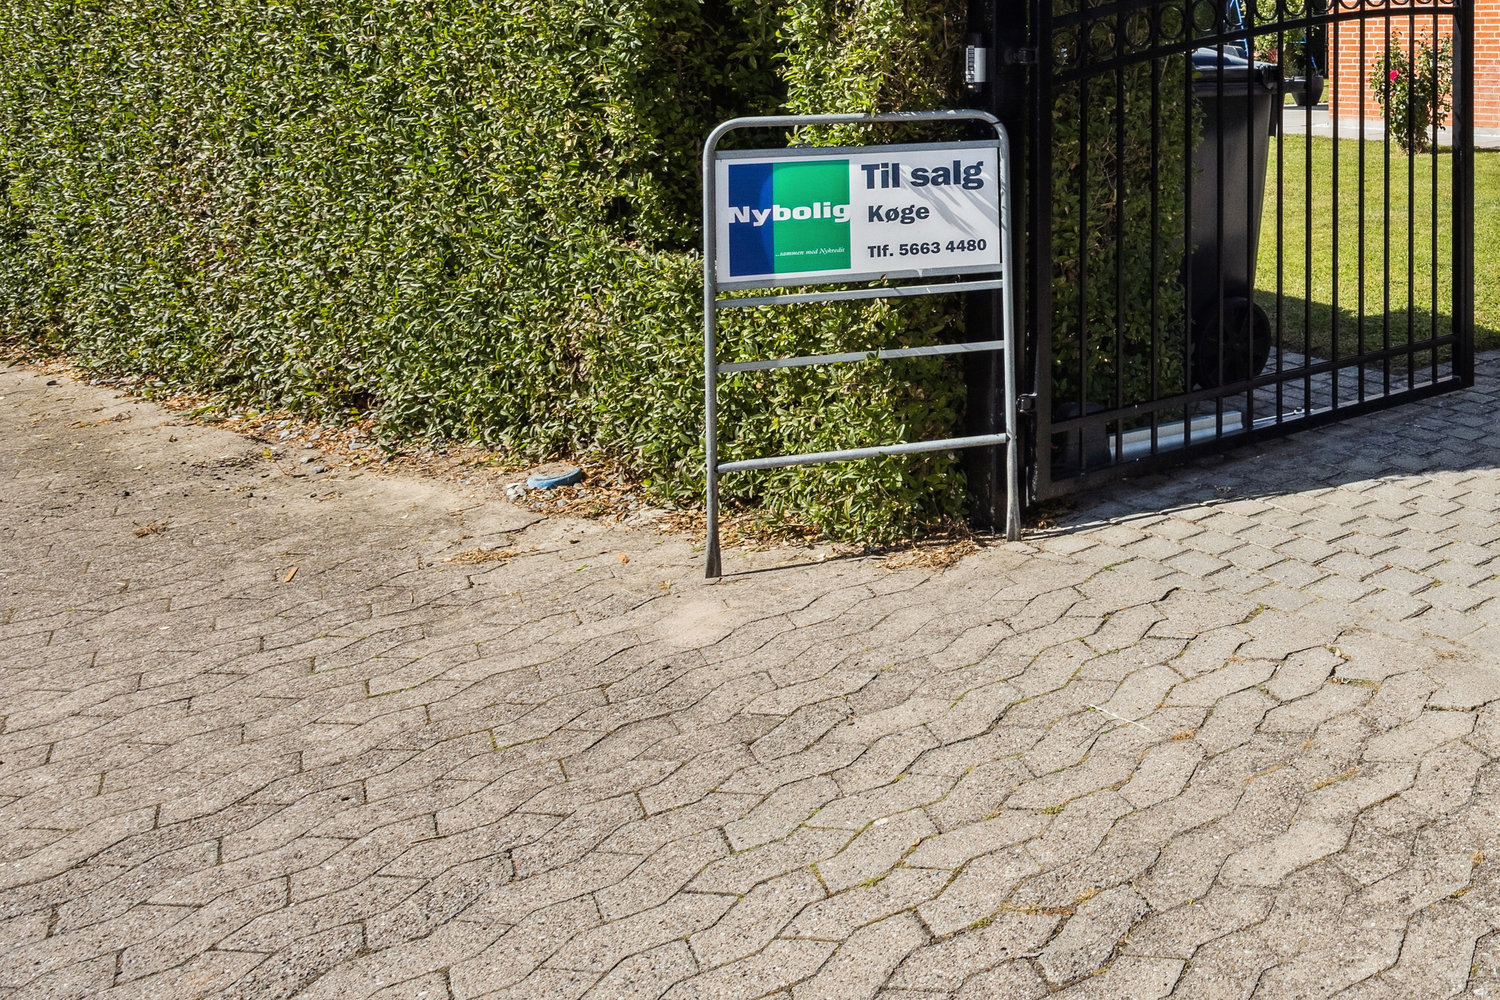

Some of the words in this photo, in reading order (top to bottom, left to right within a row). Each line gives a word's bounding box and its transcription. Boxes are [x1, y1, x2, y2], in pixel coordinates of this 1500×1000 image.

[861, 162, 900, 190] Til
[910, 159, 984, 190] salg
[728, 201, 851, 227] Nybolig
[868, 204, 930, 225] Køge
[867, 244, 894, 258] Tlf.
[899, 241, 941, 257] 5663
[945, 238, 987, 254] 4480
